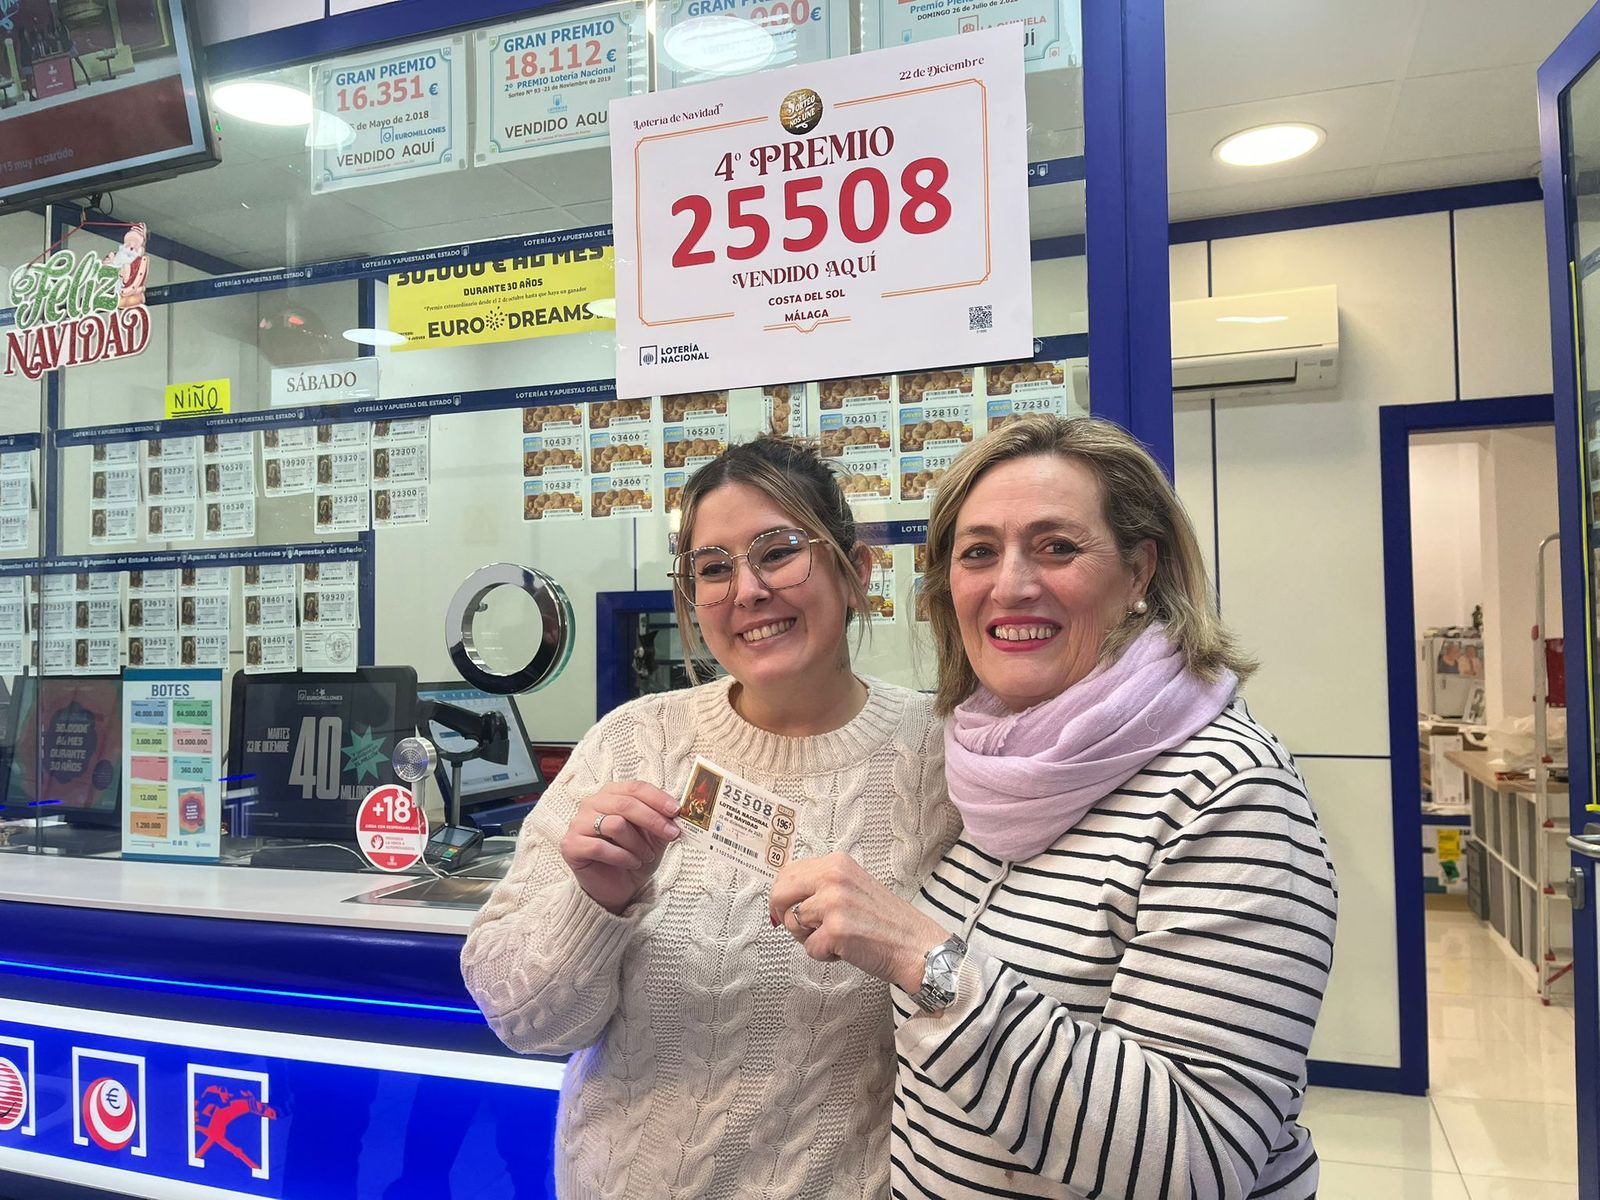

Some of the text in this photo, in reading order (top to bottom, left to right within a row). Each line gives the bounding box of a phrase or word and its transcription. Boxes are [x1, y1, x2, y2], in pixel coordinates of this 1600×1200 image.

[687, 0, 736, 17] GRAN
[810, 7, 821, 21] €
[910, 0, 944, 14] Premio
[917, 9, 951, 20] DOMINGO
[972, 2, 988, 10] Julio
[504, 20, 614, 52] GRAN PREMIO
[506, 40, 616, 81] 18.112 €
[900, 56, 985, 80] 22 de Diciembre
[336, 56, 436, 86] GRAN PREMIO
[517, 77, 549, 89] PREMIO
[580, 66, 616, 77] Nacional
[560, 80, 588, 88] Noviembre
[336, 75, 439, 112] 16.351 €
[356, 110, 429, 130] de Mayo de 2.018
[670, 114, 681, 123] de
[682, 103, 724, 121] Navidad
[802, 108, 816, 120] UNE
[505, 117, 568, 138] VENDIDO
[576, 110, 608, 127] AQU
[394, 126, 446, 140] EUROMILLONES
[336, 148, 395, 167] VENDIDO
[402, 138, 435, 158] AQUÍ
[714, 126, 894, 182] 4º PREMIO
[672, 156, 952, 268] 25508
[524, 236, 556, 246] LOTERÍAS
[732, 250, 877, 288] VENDIDO AQUÍ
[10, 250, 120, 328] Feliz
[463, 278, 543, 296] DURANTE 30 AÑOS
[568, 287, 587, 295] ganador
[768, 288, 846, 306] COSTA DEL SOL
[428, 302, 594, 338] EURO DREAMS
[784, 308, 829, 322] MÁLAGA
[4, 306, 150, 379] NAVIDAD
[660, 343, 700, 356] LOTERÍA
[660, 352, 710, 364] NACIONAL
[286, 372, 357, 393] SÁBADO
[174, 384, 218, 408] NIÑO
[516, 390, 548, 399] LOTERÍAS
[354, 404, 383, 413] LOTERÍAS
[1014, 400, 1050, 410] 27230
[845, 414, 877, 424] 70201
[925, 408, 959, 418] 32810
[611, 433, 640, 442] 63466
[686, 427, 716, 436] 16520
[544, 438, 572, 446] 10433
[334, 454, 358, 462] 35320
[390, 448, 416, 456] 22300
[925, 458, 951, 467] 3281
[544, 482, 572, 490] 10433
[612, 478, 641, 486] 63466
[334, 495, 358, 503] 35320
[391, 489, 417, 498] 22300
[152, 684, 190, 696] BOTES
[288, 717, 343, 800] 40
[723, 784, 773, 816] 25508
[372, 796, 411, 823] +18
[720, 801, 741, 815] LOTERÍA
[742, 811, 769, 829] NACIONAL
[734, 814, 759, 830] NAVIDAD
[771, 852, 781, 861] 20
